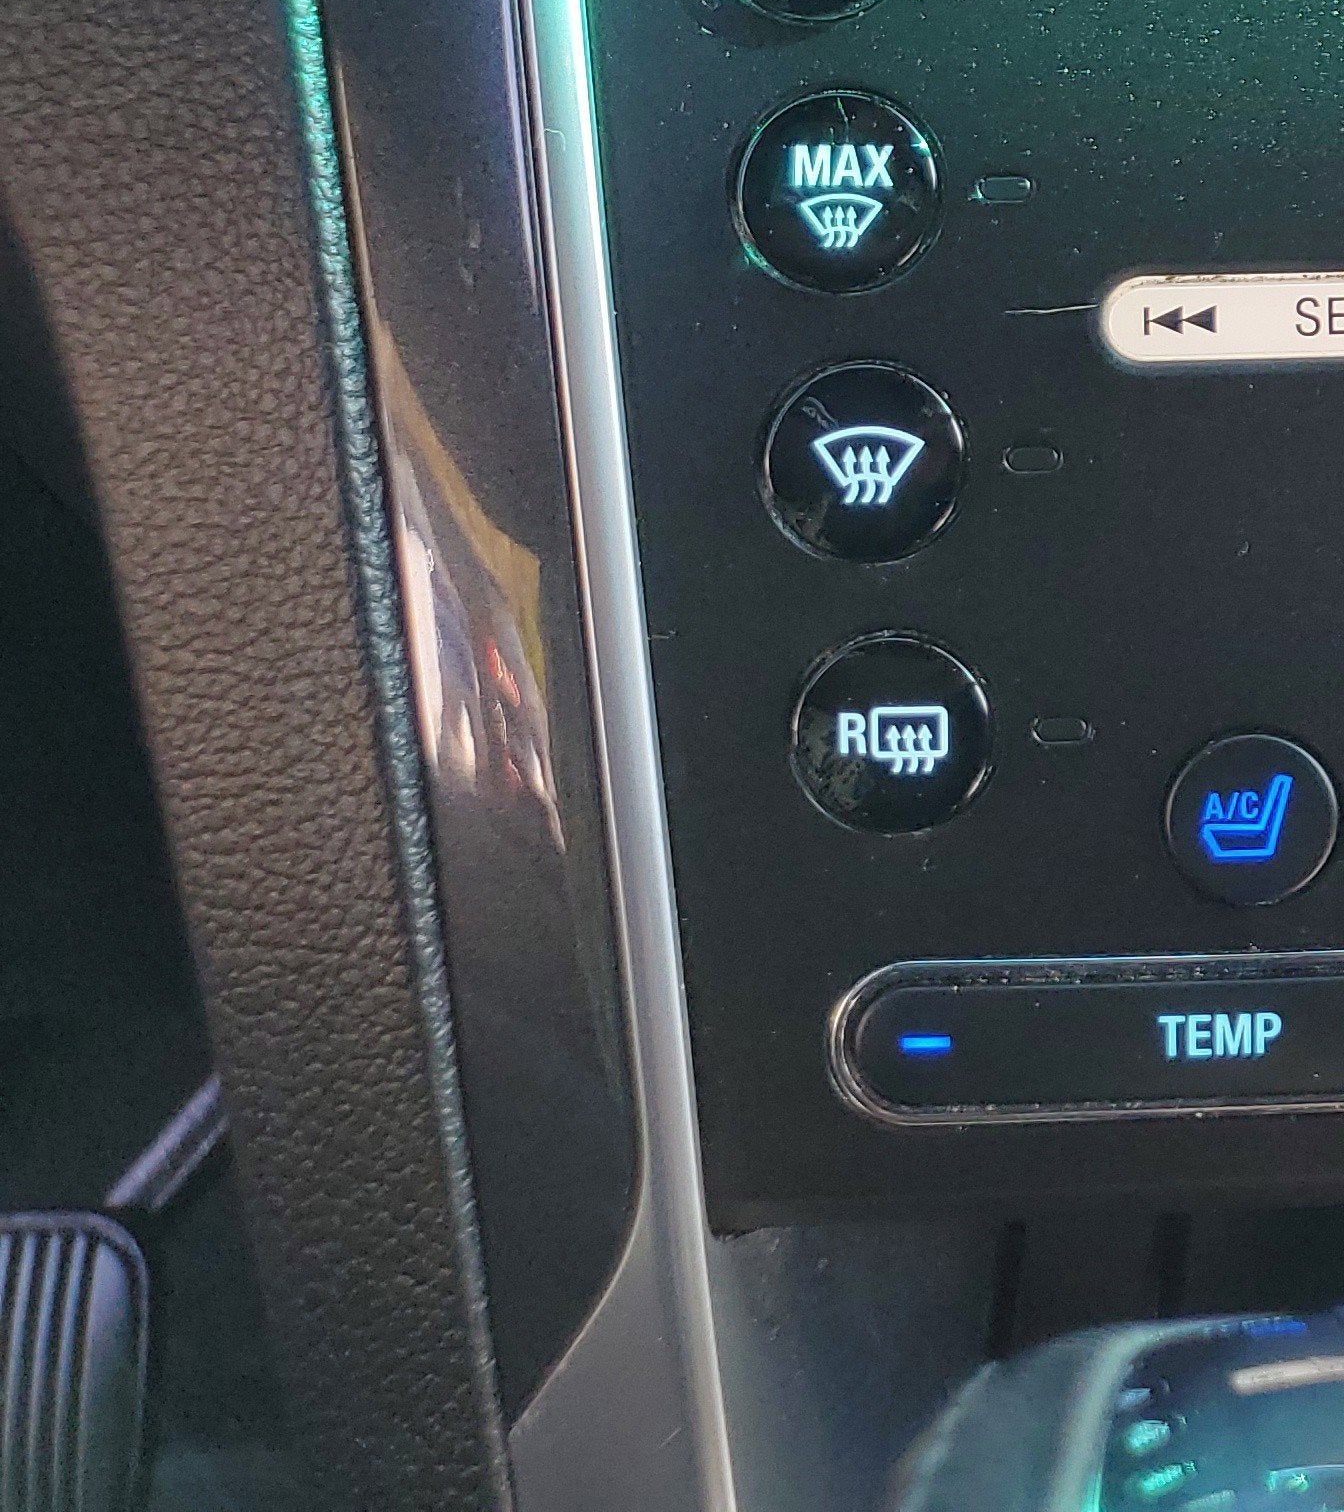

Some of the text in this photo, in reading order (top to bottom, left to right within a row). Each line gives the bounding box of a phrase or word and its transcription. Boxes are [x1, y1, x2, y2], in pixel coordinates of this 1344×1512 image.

[792, 146, 895, 188] MAX
[837, 714, 868, 756] R
[1203, 792, 1260, 822] A/C
[1159, 1012, 1282, 1057] TEMP
